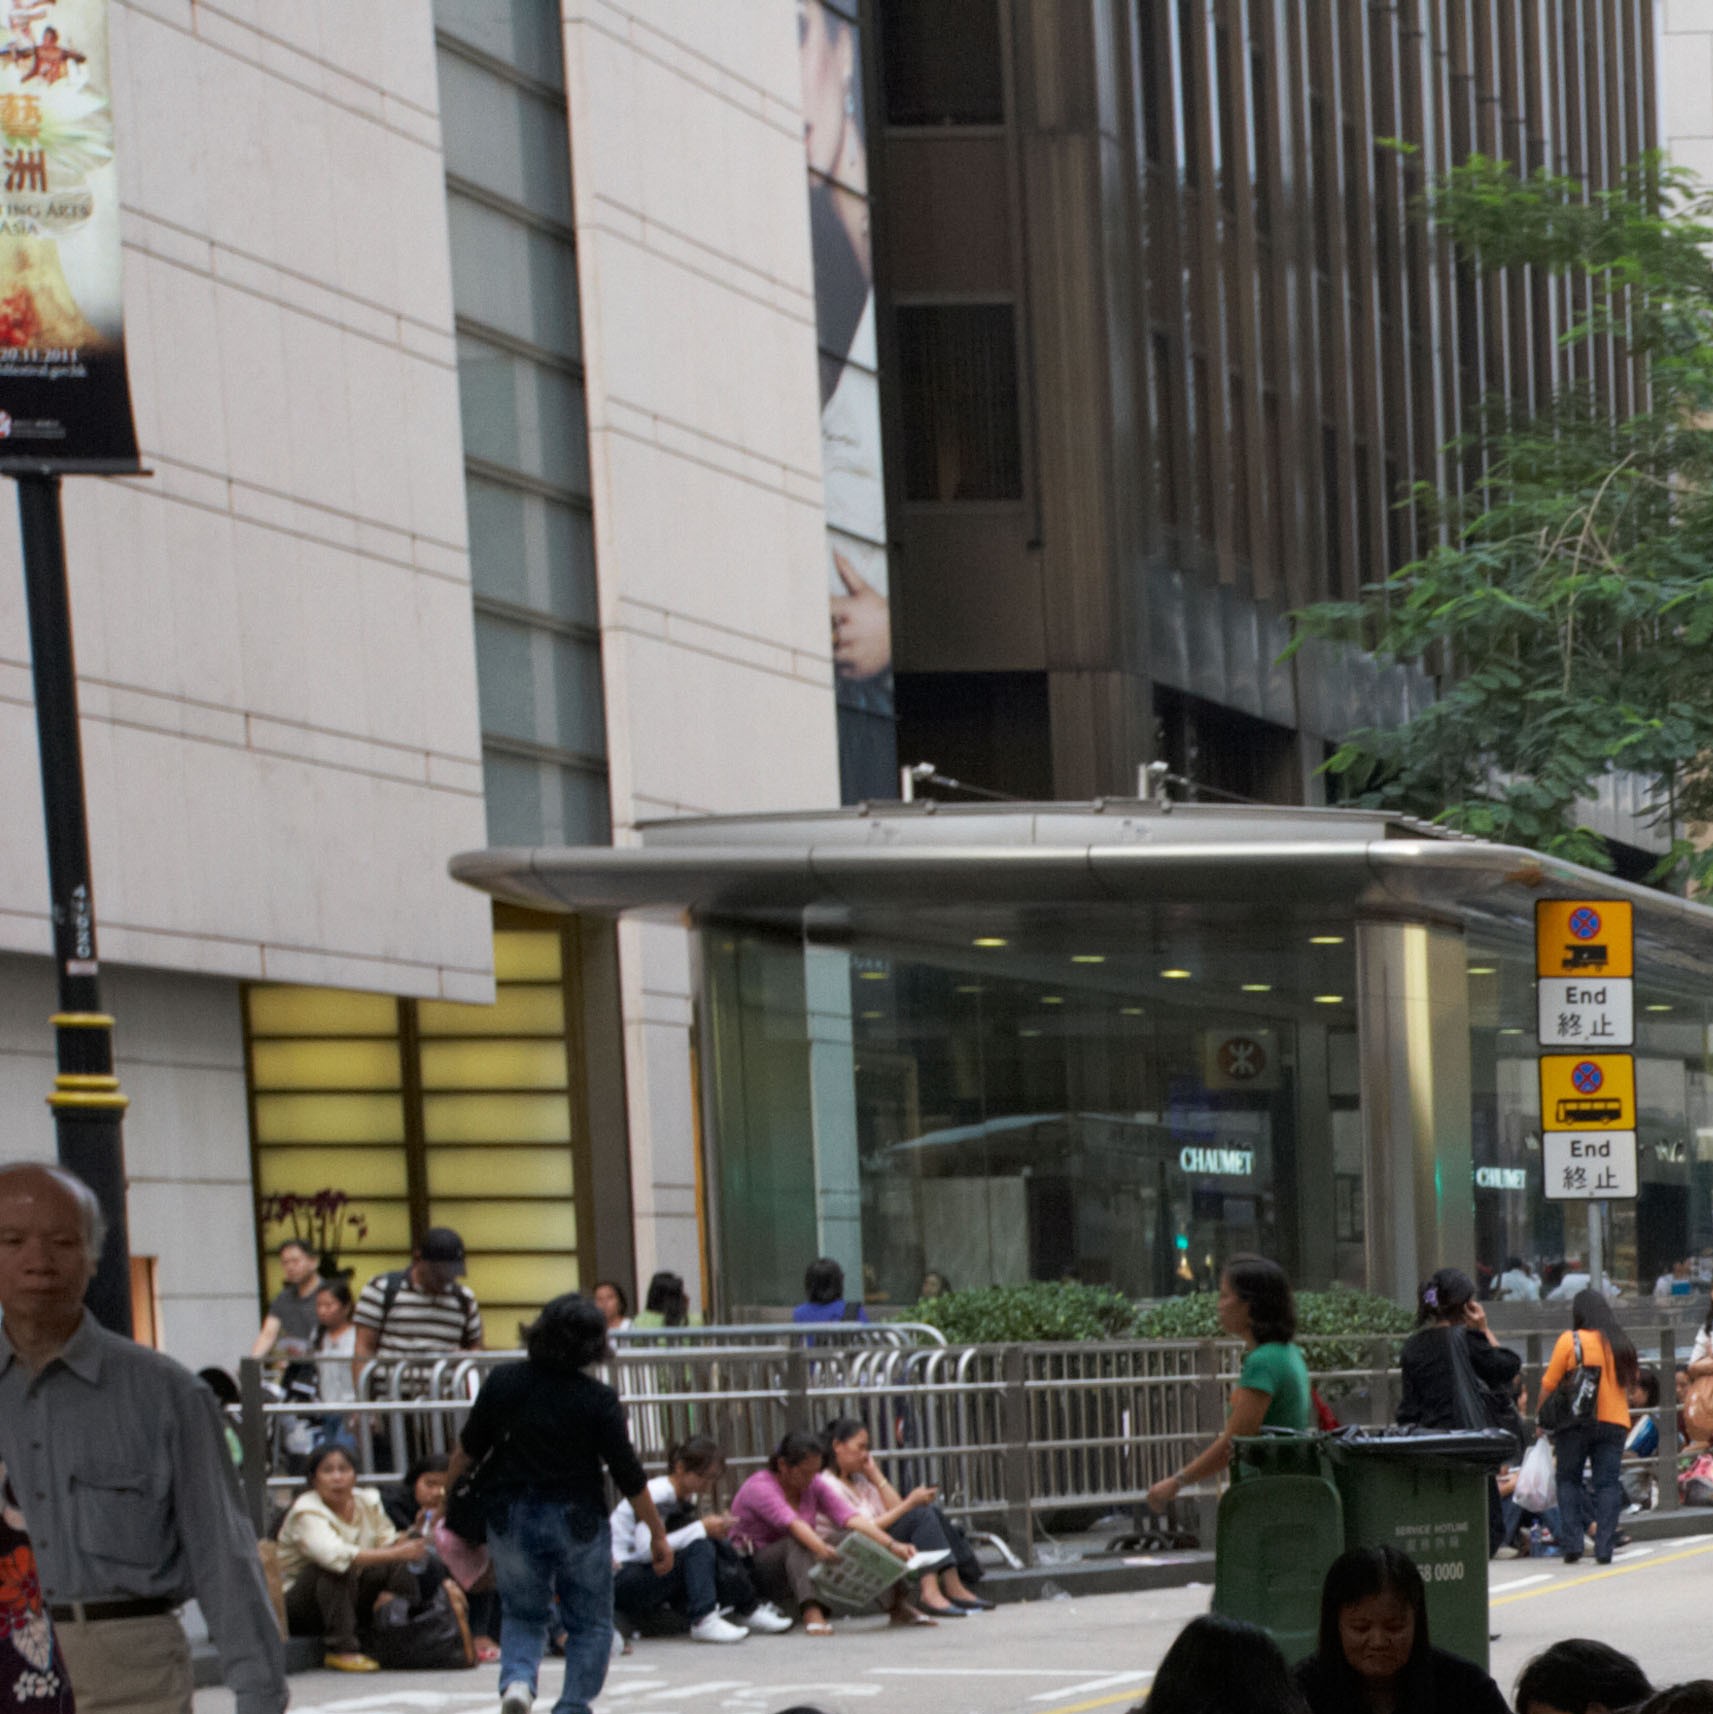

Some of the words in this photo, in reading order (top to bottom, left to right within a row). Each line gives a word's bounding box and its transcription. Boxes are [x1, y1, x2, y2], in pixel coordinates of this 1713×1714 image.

[1565, 986, 1607, 1005] End
[1557, 1012, 1615, 1038] 終止
[1570, 1140, 1611, 1159] End
[1180, 1146, 1255, 1176] CHAUMET
[1562, 1166, 1619, 1191] 終止
[1434, 1561, 1464, 1581] 0000
